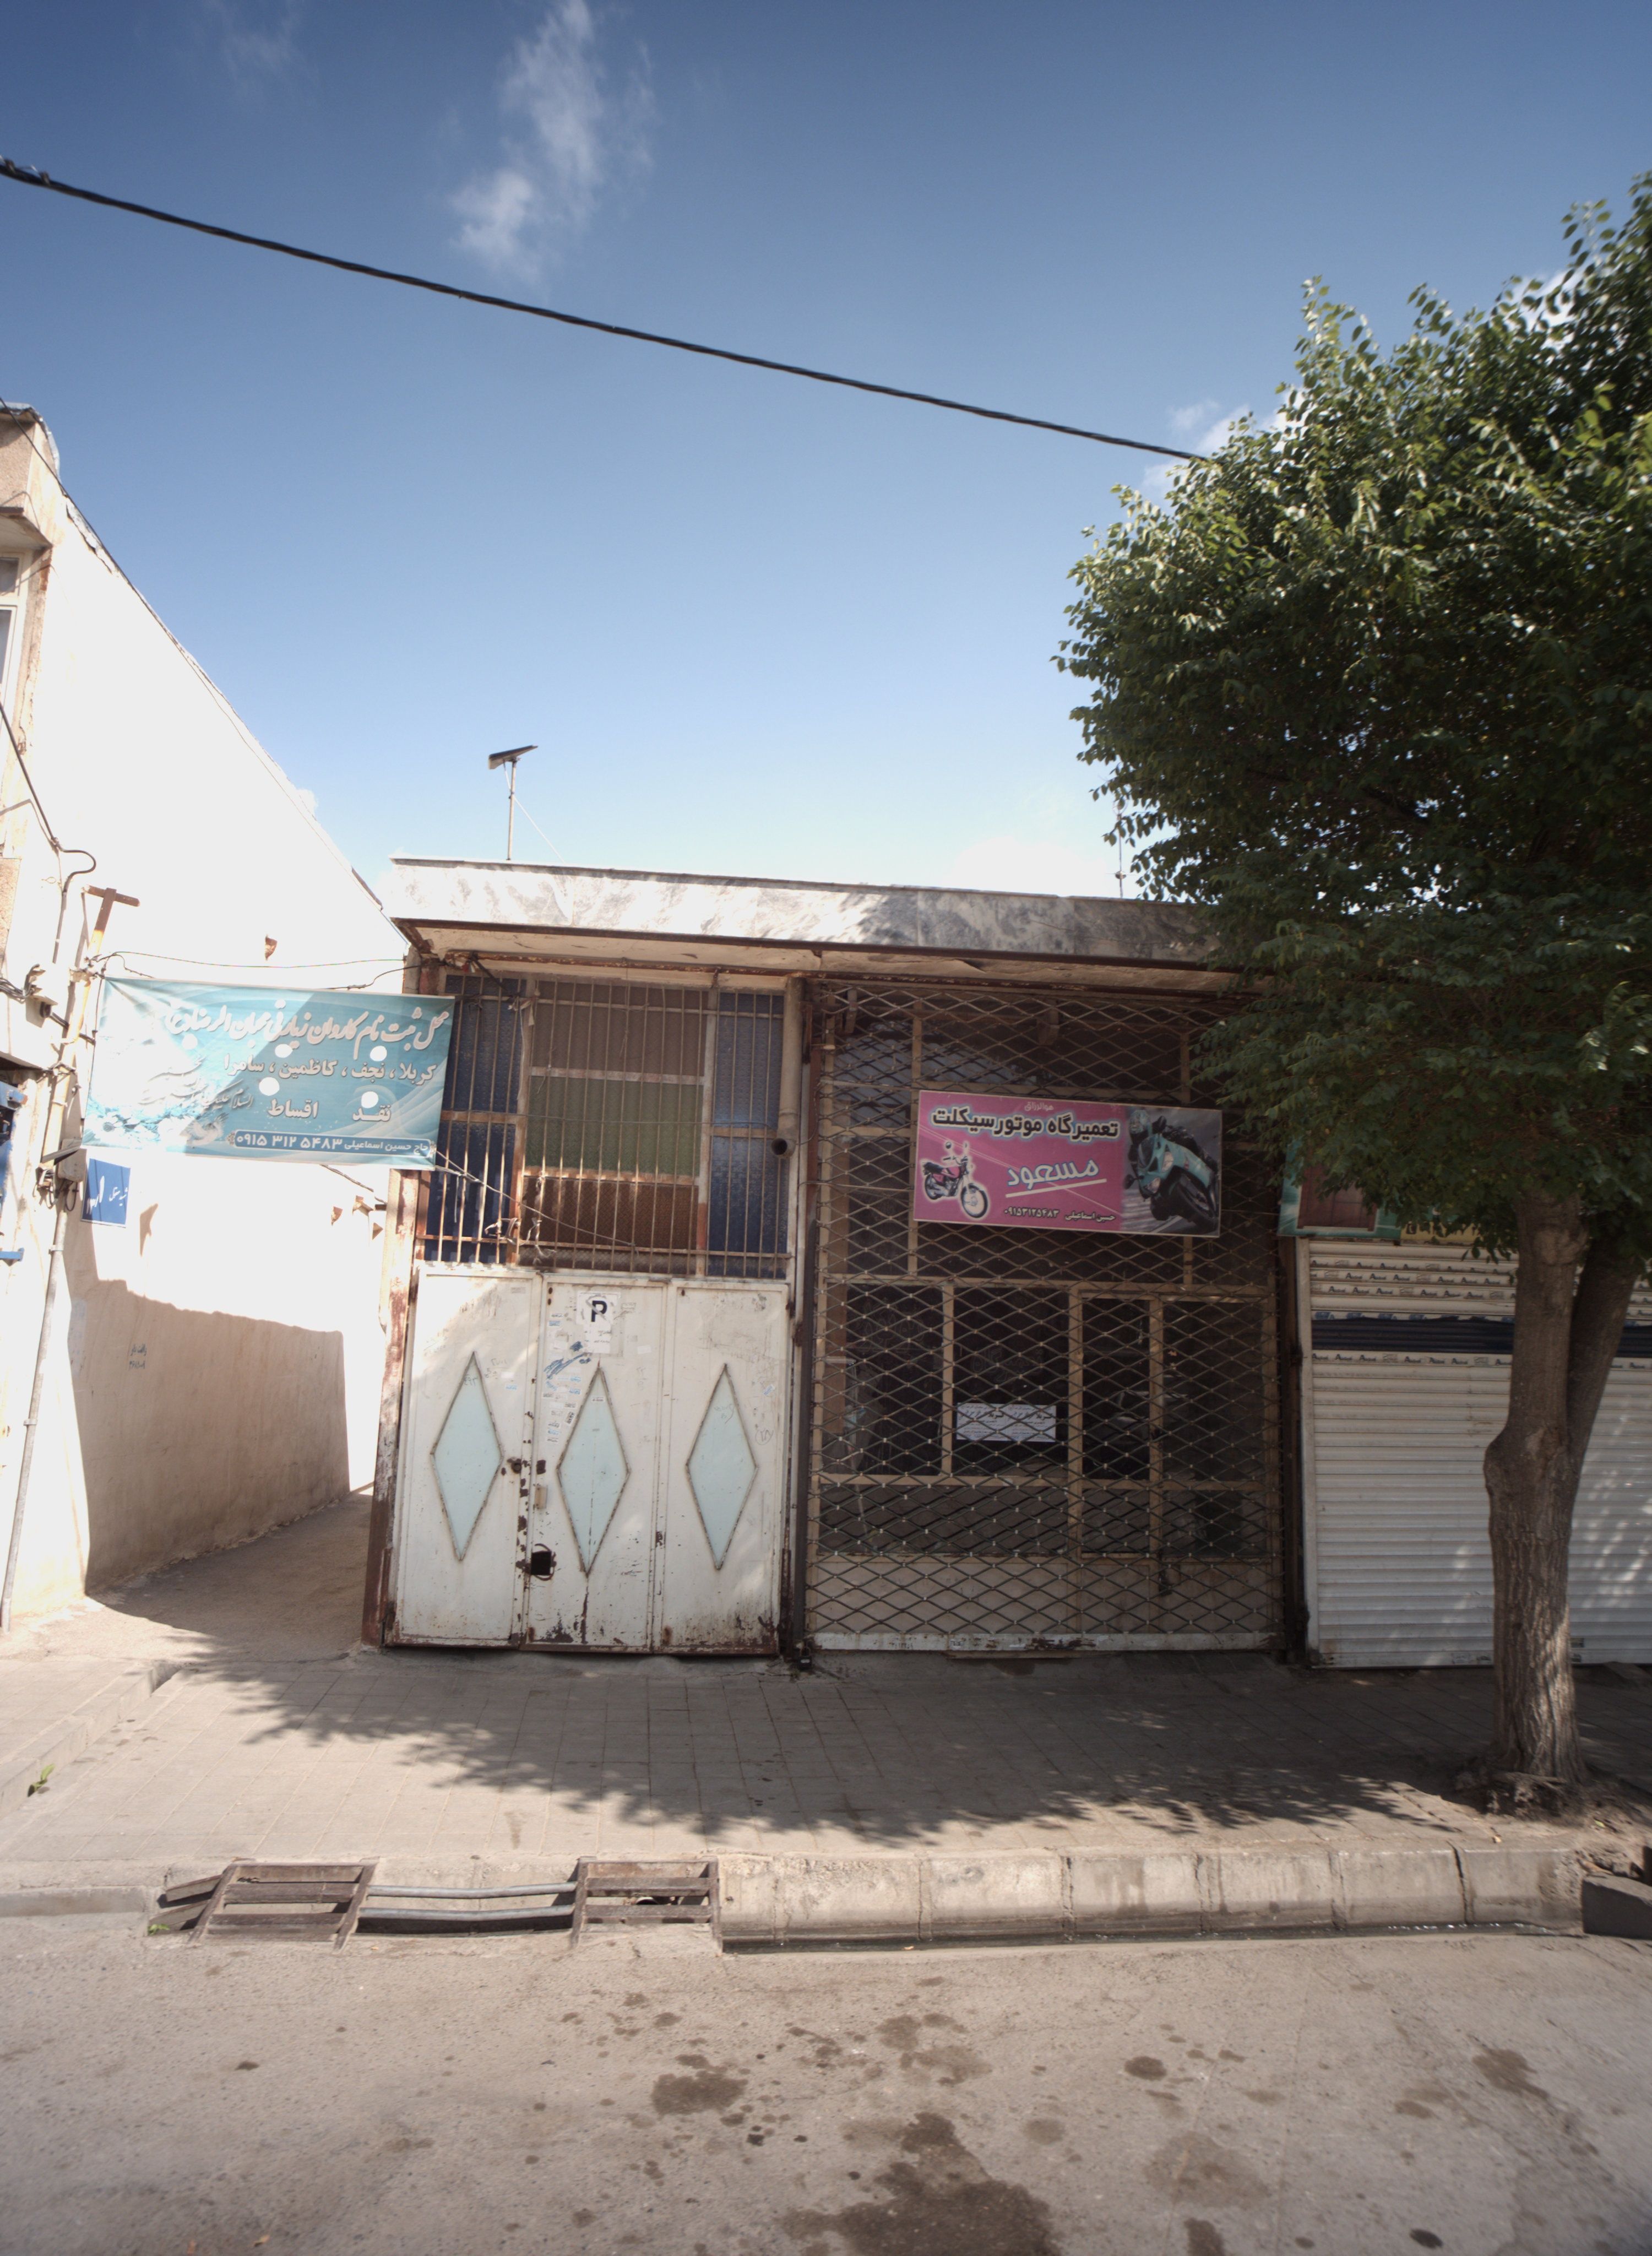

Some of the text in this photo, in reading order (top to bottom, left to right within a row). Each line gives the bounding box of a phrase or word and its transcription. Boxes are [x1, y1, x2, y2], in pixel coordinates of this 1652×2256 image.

[263, 998, 313, 1050] زیارتی
[307, 1010, 369, 1045] کاروان
[380, 1006, 423, 1052] ثبت
[414, 1011, 449, 1050] محل
[353, 1014, 385, 1060] نام
[224, 1053, 265, 1076] سامرا
[267, 1098, 319, 1119] اقساط
[352, 1104, 392, 1122] نقد
[236, 1133, 428, 1156] حاج حسین اسماعیلی ۰۹۱۵ ۳۱۲ ۵۴۸۳
[1007, 1159, 1100, 1190] مسعود
[1064, 1211, 1096, 1221] اسماعیلی
[1095, 1214, 1116, 1222] حسین
[591, 1300, 608, 1322] P
